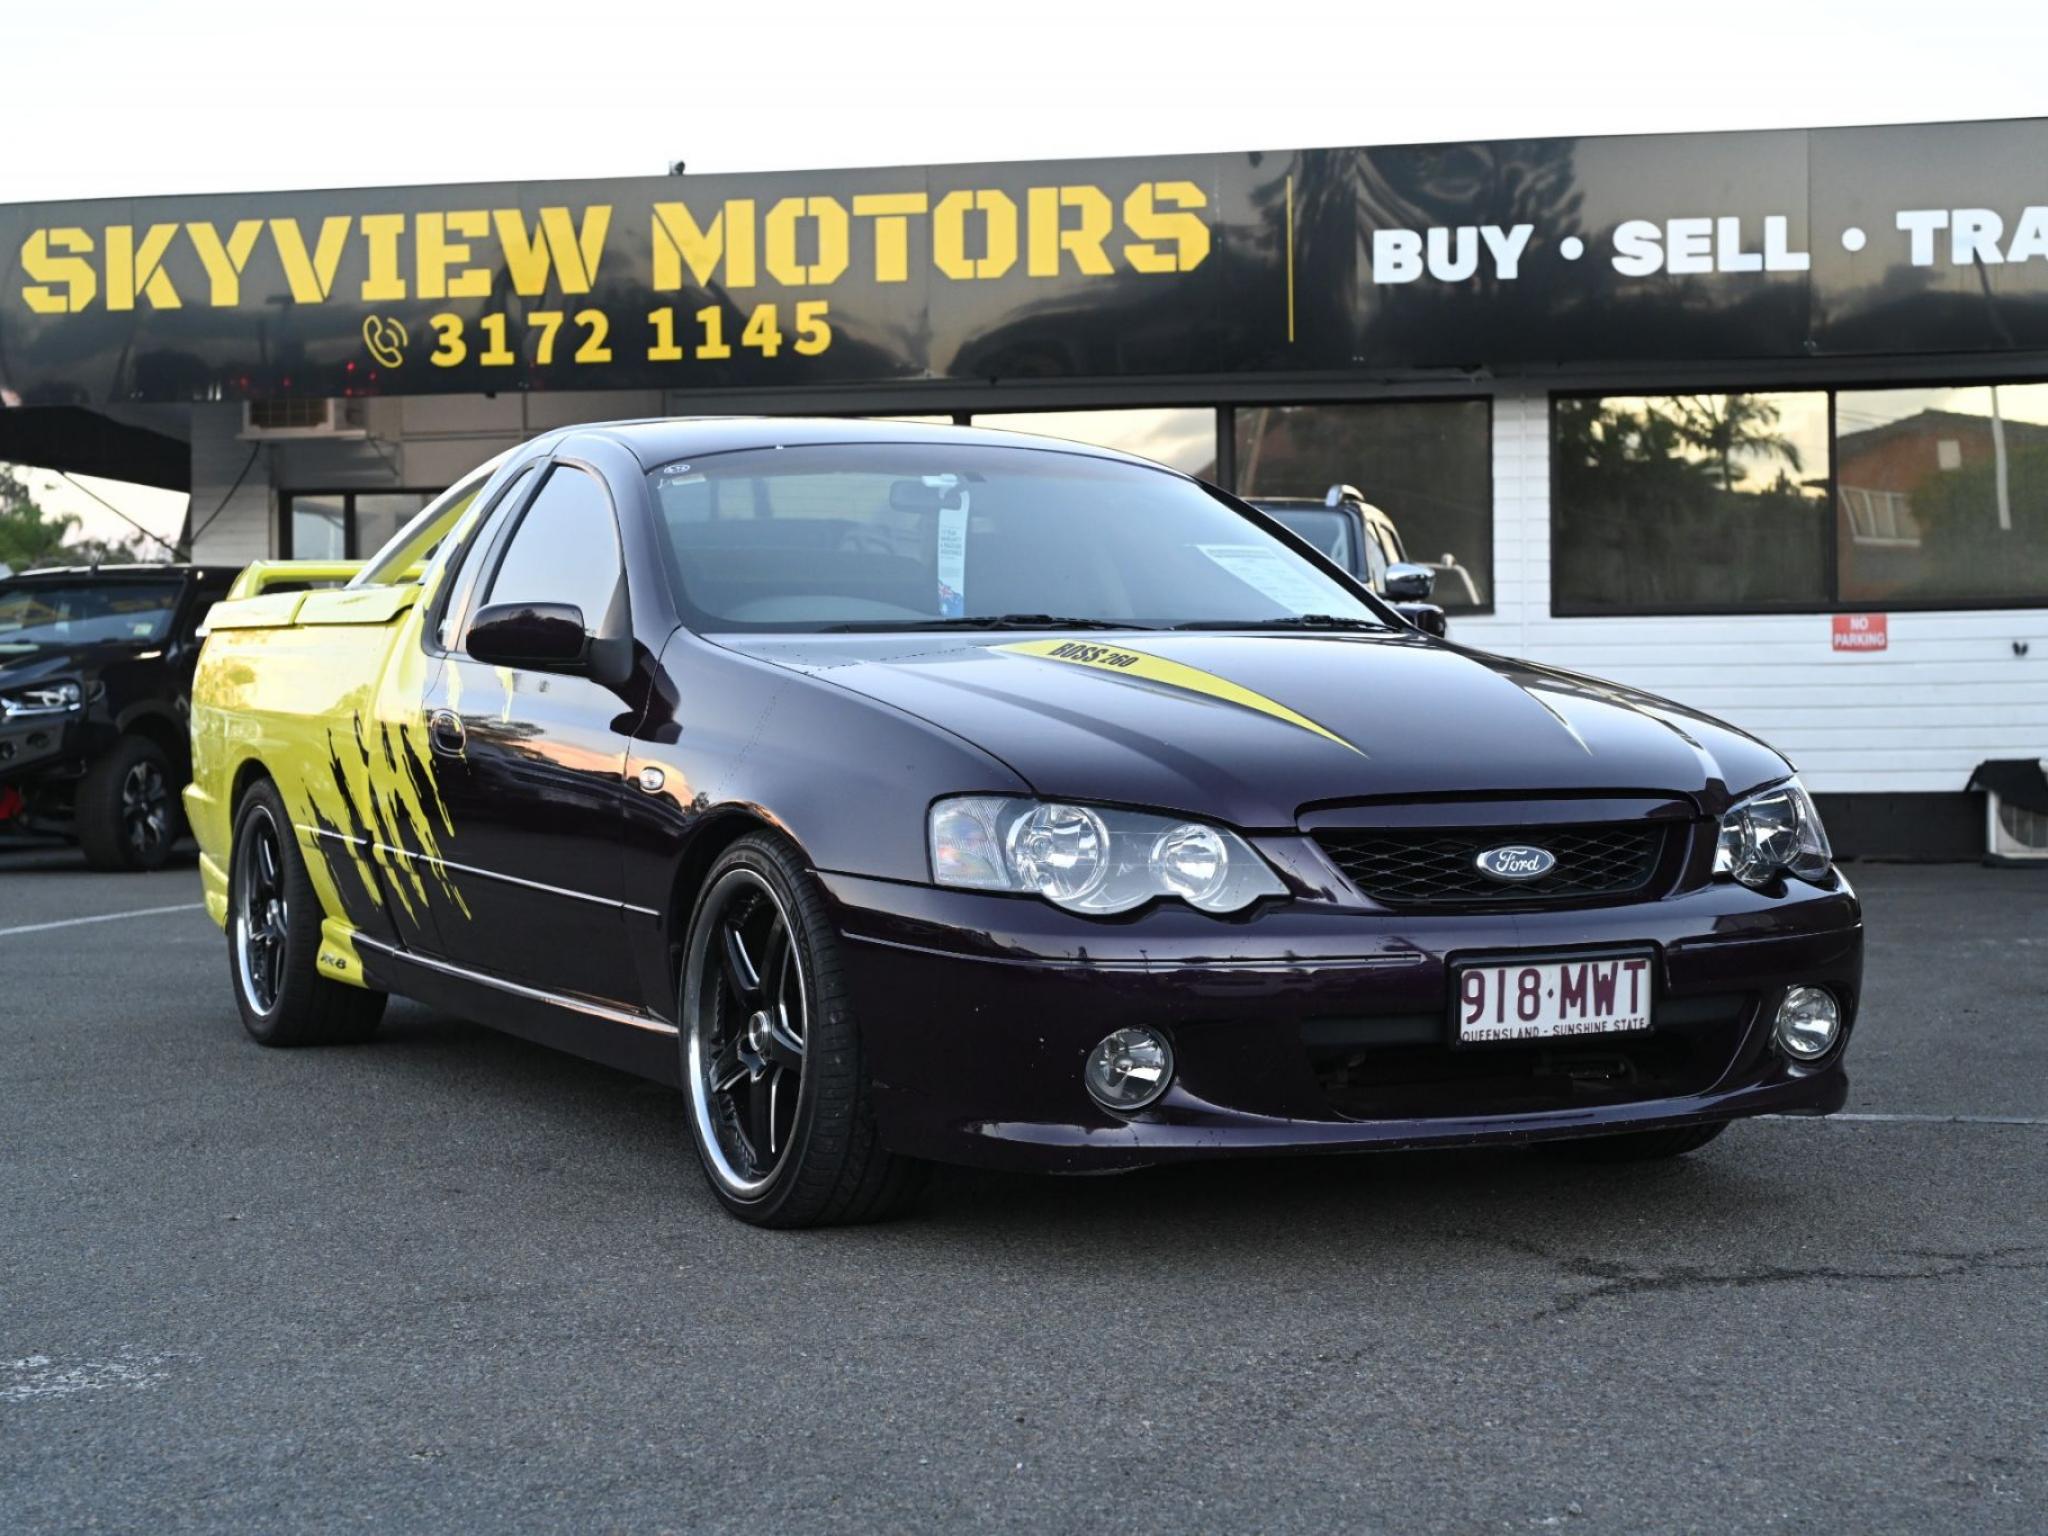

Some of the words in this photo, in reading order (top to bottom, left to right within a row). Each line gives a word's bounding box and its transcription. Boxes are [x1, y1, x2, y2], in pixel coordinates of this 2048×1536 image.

[20, 204, 613, 314] SKYVIEW
[651, 181, 1211, 292] MOTORS
[1372, 223, 1534, 285] BUY
[1611, 215, 1811, 277] SELL
[1896, 206, 2048, 267] TRA
[429, 308, 612, 367] 3172
[647, 300, 832, 361] 1145
[1850, 616, 1869, 630] NO
[1834, 632, 1886, 647] PARKING
[1048, 643, 1109, 662] BOSS
[1098, 653, 1139, 668] 260
[1496, 850, 1540, 872] Ford
[1462, 1026, 1539, 1041] QUEENSLAND
[1553, 1021, 1607, 1036] SUNSHINE
[1614, 1017, 1645, 1030] STATE
